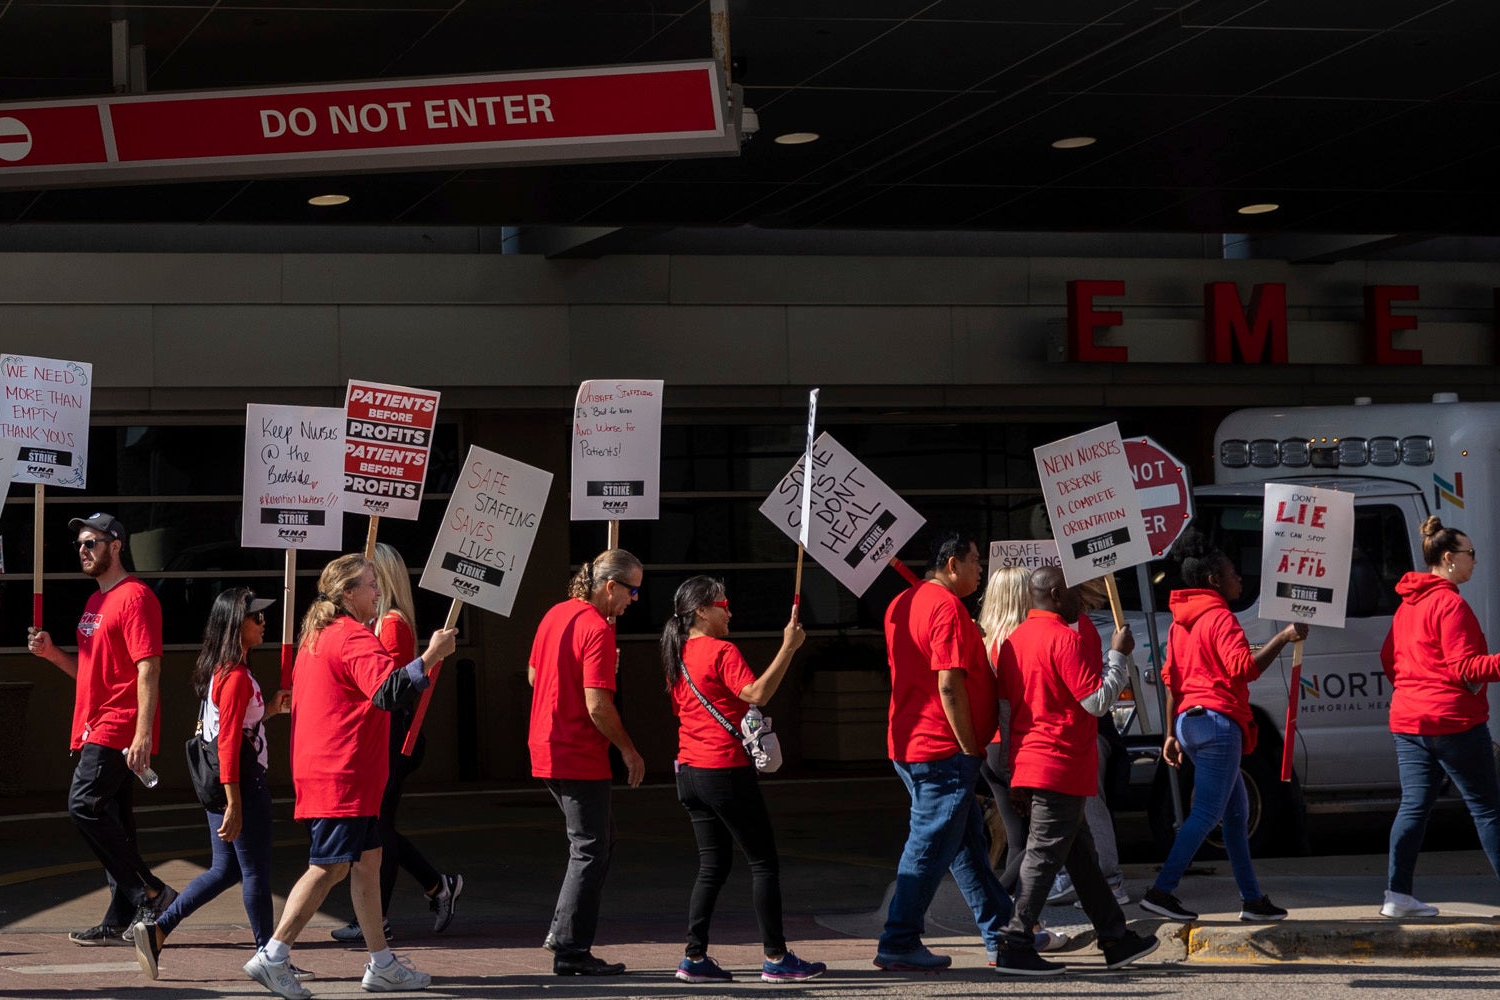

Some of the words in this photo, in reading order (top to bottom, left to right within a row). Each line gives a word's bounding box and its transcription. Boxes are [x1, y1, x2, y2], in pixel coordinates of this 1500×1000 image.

[260, 107, 317, 138] DO
[329, 101, 411, 134] NOT
[424, 94, 555, 129] ENTER
[1067, 280, 1500, 365] EME
[7, 363, 28, 378] WE
[34, 366, 75, 384] NEED
[6, 386, 42, 401] MORE
[48, 390, 82, 408] THAN
[350, 389, 435, 412] PATIENTS
[12, 405, 58, 423] EMPTY
[368, 408, 414, 423] BEFORE
[262, 417, 293, 444] Keep
[300, 420, 338, 441] Nurses
[349, 421, 425, 444] PROFITS
[28, 452, 57, 464] STRIKE
[261, 444, 280, 465] @
[287, 445, 313, 463] the
[345, 443, 426, 466] PATIENTS
[580, 440, 622, 458] Patients!
[1043, 454, 1074, 477] NEW
[1078, 440, 1121, 466] NURSES
[268, 464, 312, 485] Bedside
[360, 462, 404, 477] BEFORE
[467, 461, 510, 496] SAFE
[344, 477, 416, 498] PROFITS
[602, 485, 630, 496] STRIKE
[1056, 471, 1103, 496] DESERVE
[474, 492, 536, 528] STAFFING
[1057, 505, 1065, 518] A
[1068, 487, 1116, 514] COMPLETE
[278, 513, 309, 524] STRIKE
[450, 507, 495, 542] SAVES
[1062, 508, 1126, 536] ORIENTATION
[1275, 501, 1328, 529] LIE
[820, 502, 881, 553] HEAL
[859, 525, 885, 554] STRIKE
[991, 543, 1041, 557] UNSAFE
[1087, 536, 1115, 553] STRIKE
[456, 562, 487, 581] STRIKE
[1002, 556, 1061, 567] STAFFING
[1276, 555, 1327, 577] A-Fib
[1291, 589, 1318, 600] STRIKE
[1300, 672, 1388, 700] NORT
[690, 683, 709, 706] UNDER
[706, 704, 734, 732] ARMOUR
[1301, 703, 1363, 713] MEMORIAL
[1368, 701, 1390, 711] HEA
